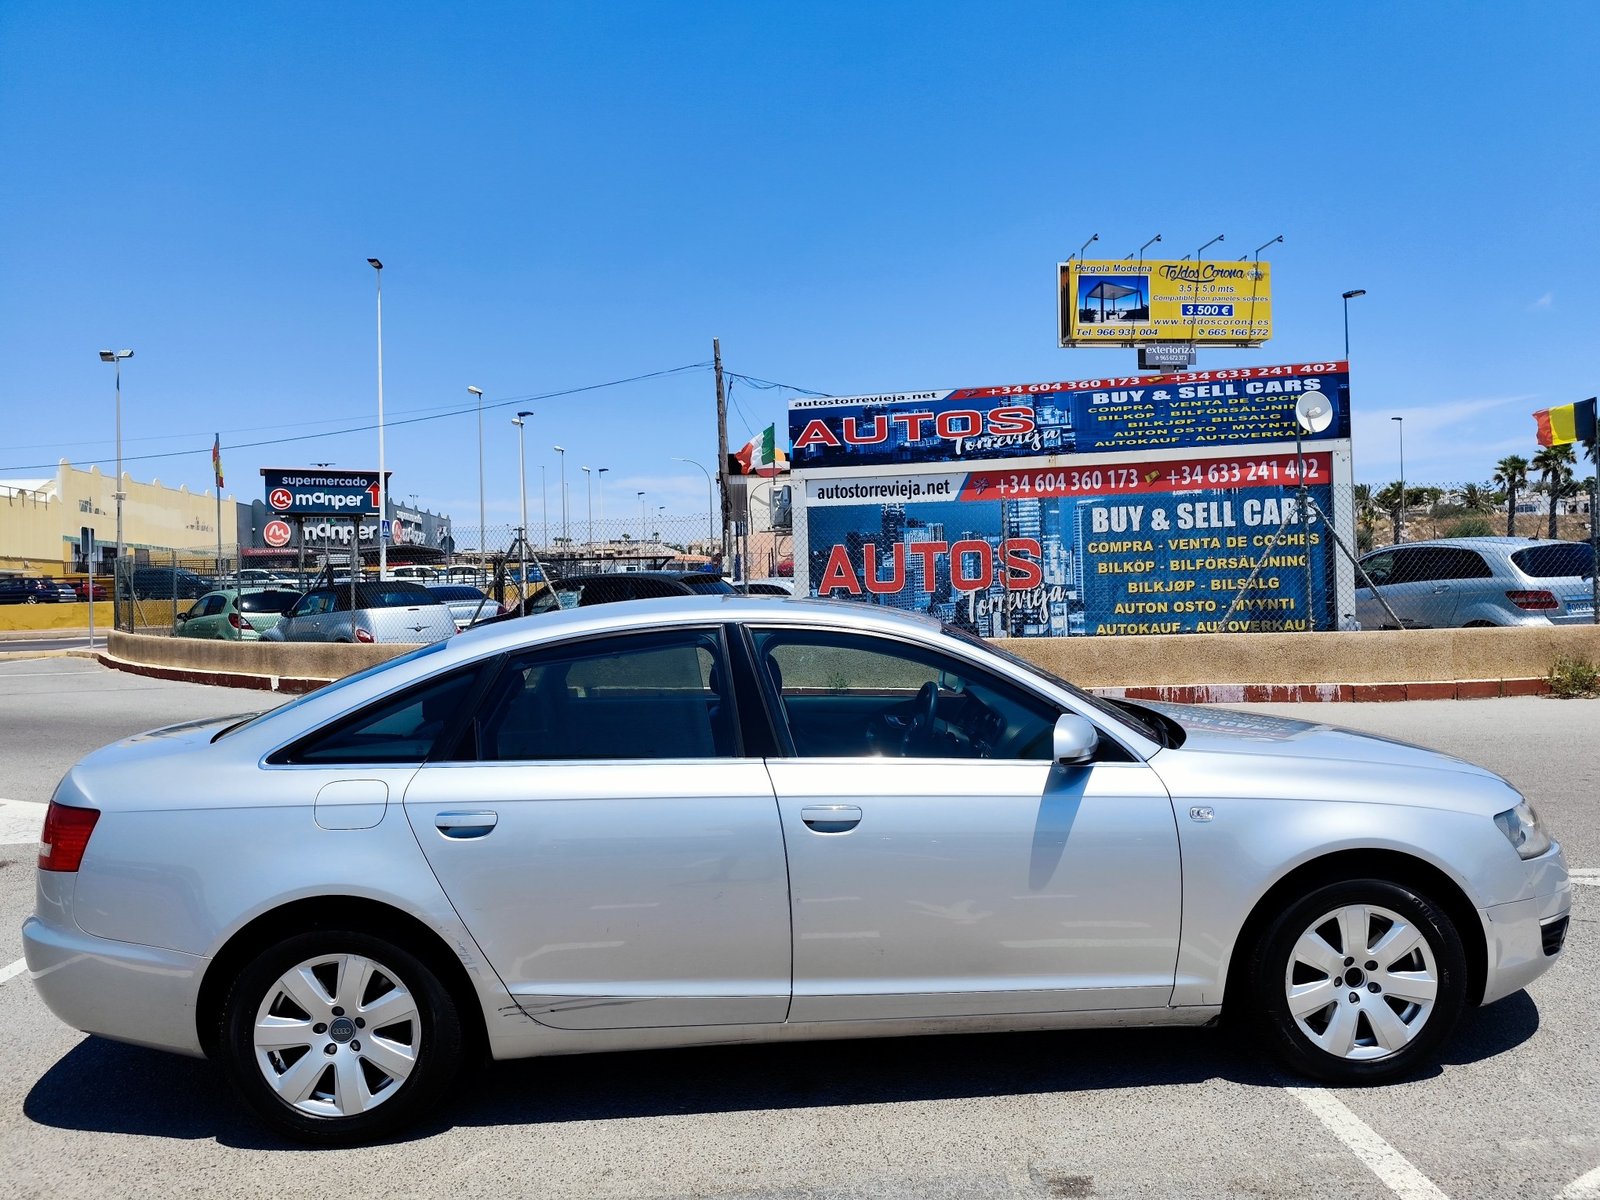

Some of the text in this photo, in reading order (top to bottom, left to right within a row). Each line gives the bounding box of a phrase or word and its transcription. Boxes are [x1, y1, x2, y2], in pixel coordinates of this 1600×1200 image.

[1113, 264, 1152, 272] Moderna
[1159, 264, 1244, 281] Toldos Corona
[1186, 306, 1230, 315] 3.500 €
[1096, 328, 1116, 336] 966
[1118, 328, 1136, 336] 931
[1140, 328, 1158, 336] 004
[1208, 328, 1269, 336] 665 166 572
[1146, 345, 1195, 354] exterioriza
[986, 362, 1338, 396] +34 604 360 173 +34 633 241 402
[1092, 378, 1322, 404] BUY & SELL CARS
[794, 392, 937, 408] autostorrevieja.net
[1088, 404, 1154, 414] COMPRA
[1169, 400, 1222, 408] VENTA
[1098, 411, 1156, 422] BILKÖP
[1128, 418, 1196, 428] BILKJØP
[1211, 414, 1282, 423] BILSALG
[793, 406, 1035, 449] AUTOS
[1114, 428, 1168, 438] AUTON
[1173, 426, 1217, 434] OSTO
[1232, 421, 1297, 431] MYYNTI
[951, 429, 1060, 455] Torrevieja
[1094, 437, 1180, 447] AUTOKAUF
[282, 476, 368, 487] supermercado
[996, 458, 1319, 494] +34 604 360 173 +34 633 241 402
[817, 479, 950, 500] autostorrevieja.net
[295, 492, 363, 510] manper
[1092, 505, 1144, 533] BUY
[1151, 508, 1170, 530] &
[1177, 500, 1236, 530] SELL
[1088, 540, 1154, 554] COMPRA
[1168, 537, 1221, 550] VENTA
[1226, 536, 1247, 548] DE
[1253, 533, 1320, 547] COCHES
[818, 538, 1043, 595] AUTOS
[1098, 558, 1156, 574] BILKÖP
[1128, 580, 1196, 594] BILKJØP
[1210, 576, 1280, 591] BILSALG
[964, 584, 1068, 624] Torrevieja
[1114, 602, 1168, 614] AUTON
[1173, 600, 1216, 612] OSTO
[1096, 622, 1180, 636] AUTOKAUF
